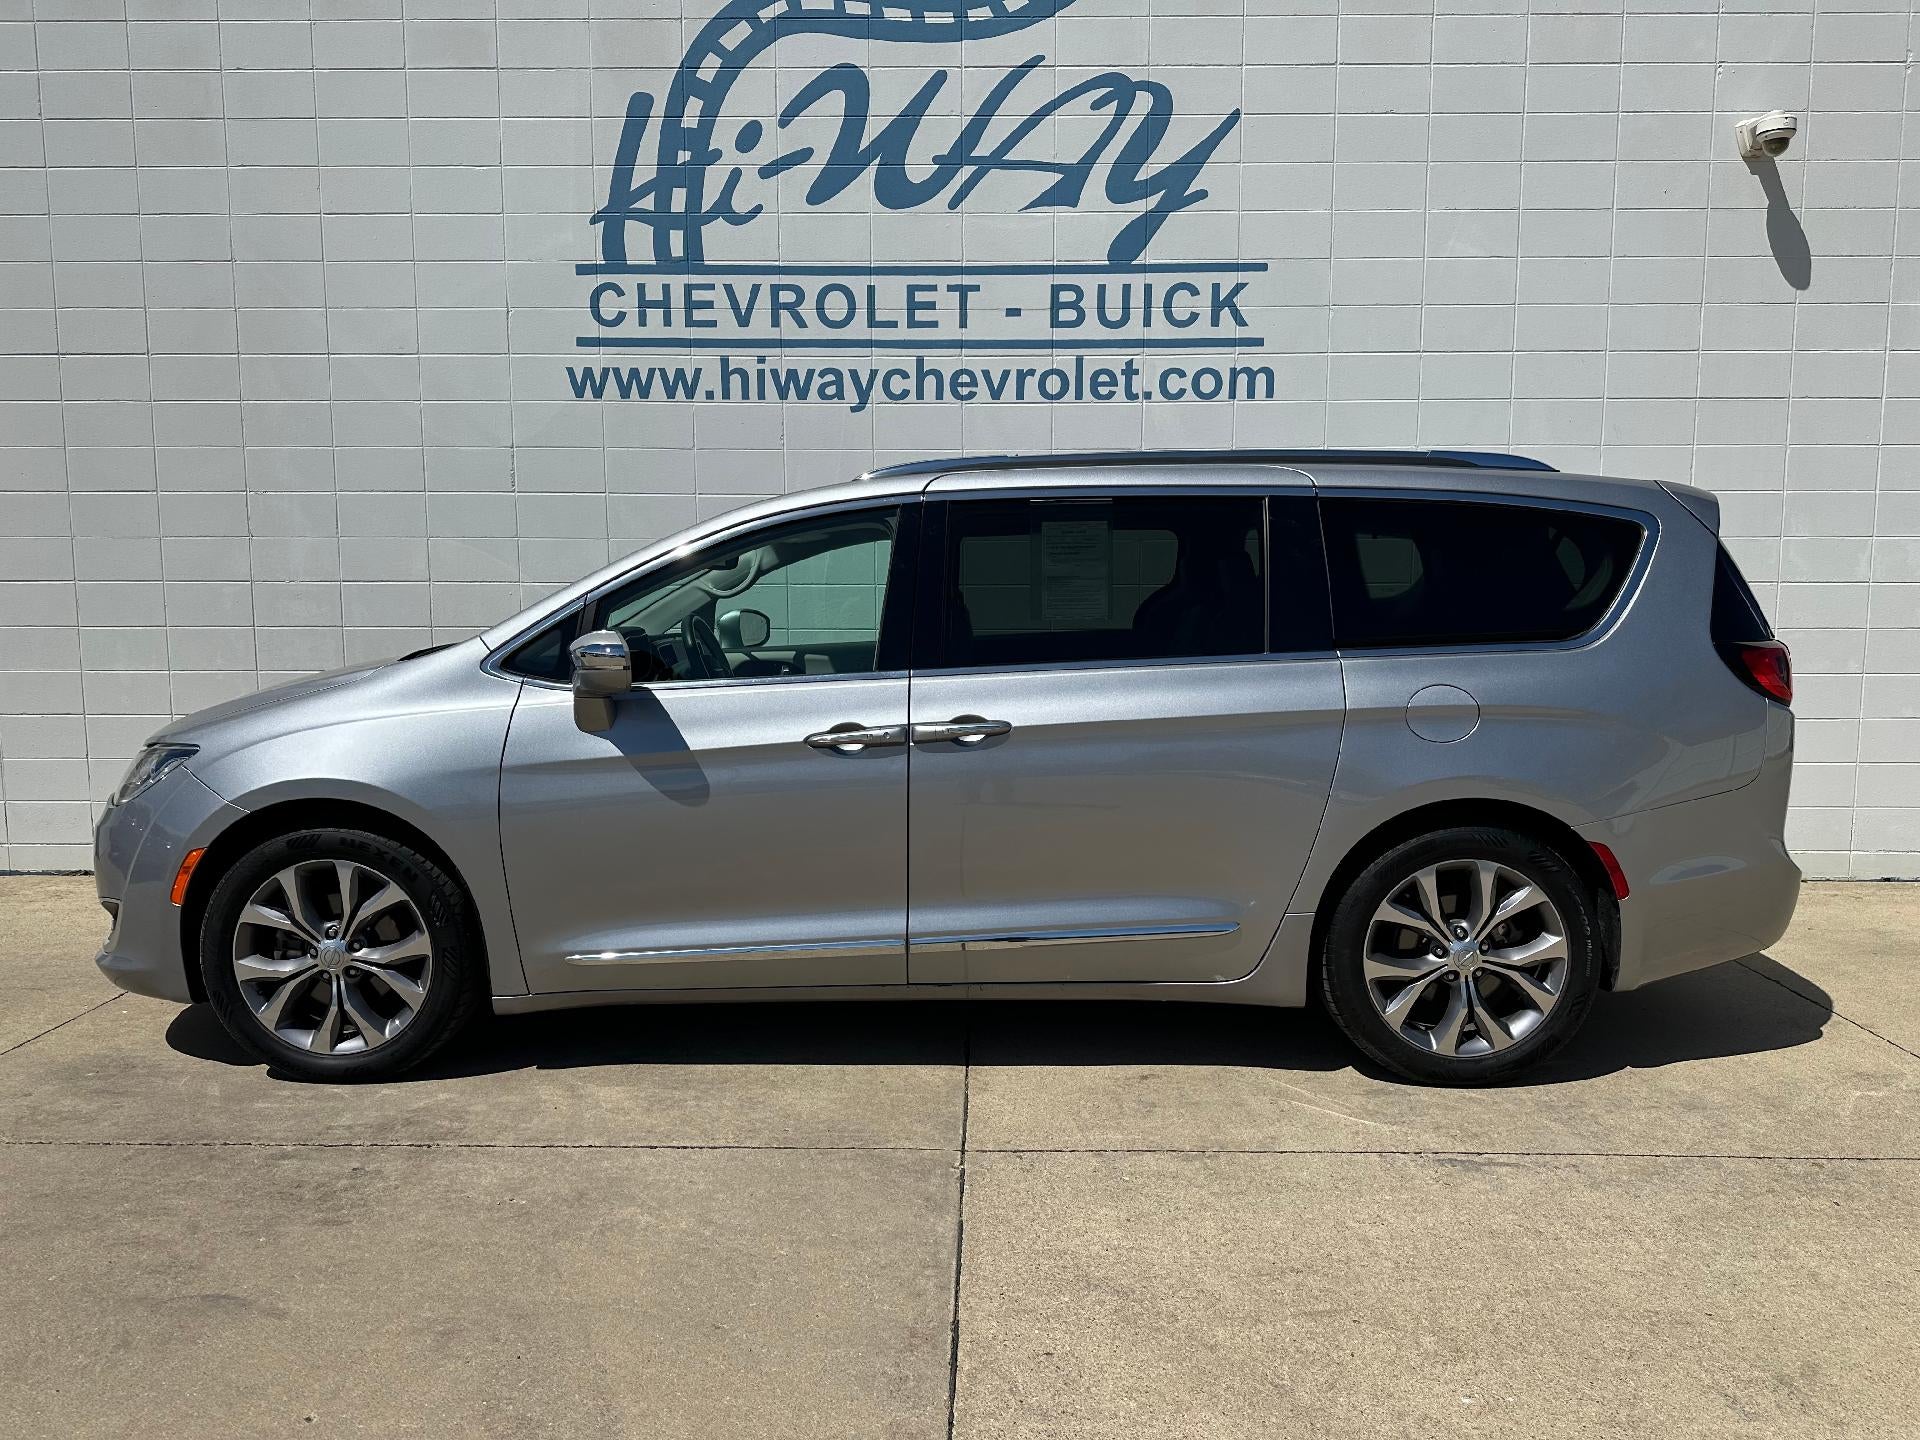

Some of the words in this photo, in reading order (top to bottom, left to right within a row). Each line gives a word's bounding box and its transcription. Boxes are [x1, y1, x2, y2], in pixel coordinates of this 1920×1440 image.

[588, 281, 982, 330] CHEVROLET
[1004, 306, 1023, 318] -
[1050, 281, 1249, 330] BUICK
[565, 354, 1276, 414] www.hiwaychevrolet.com
